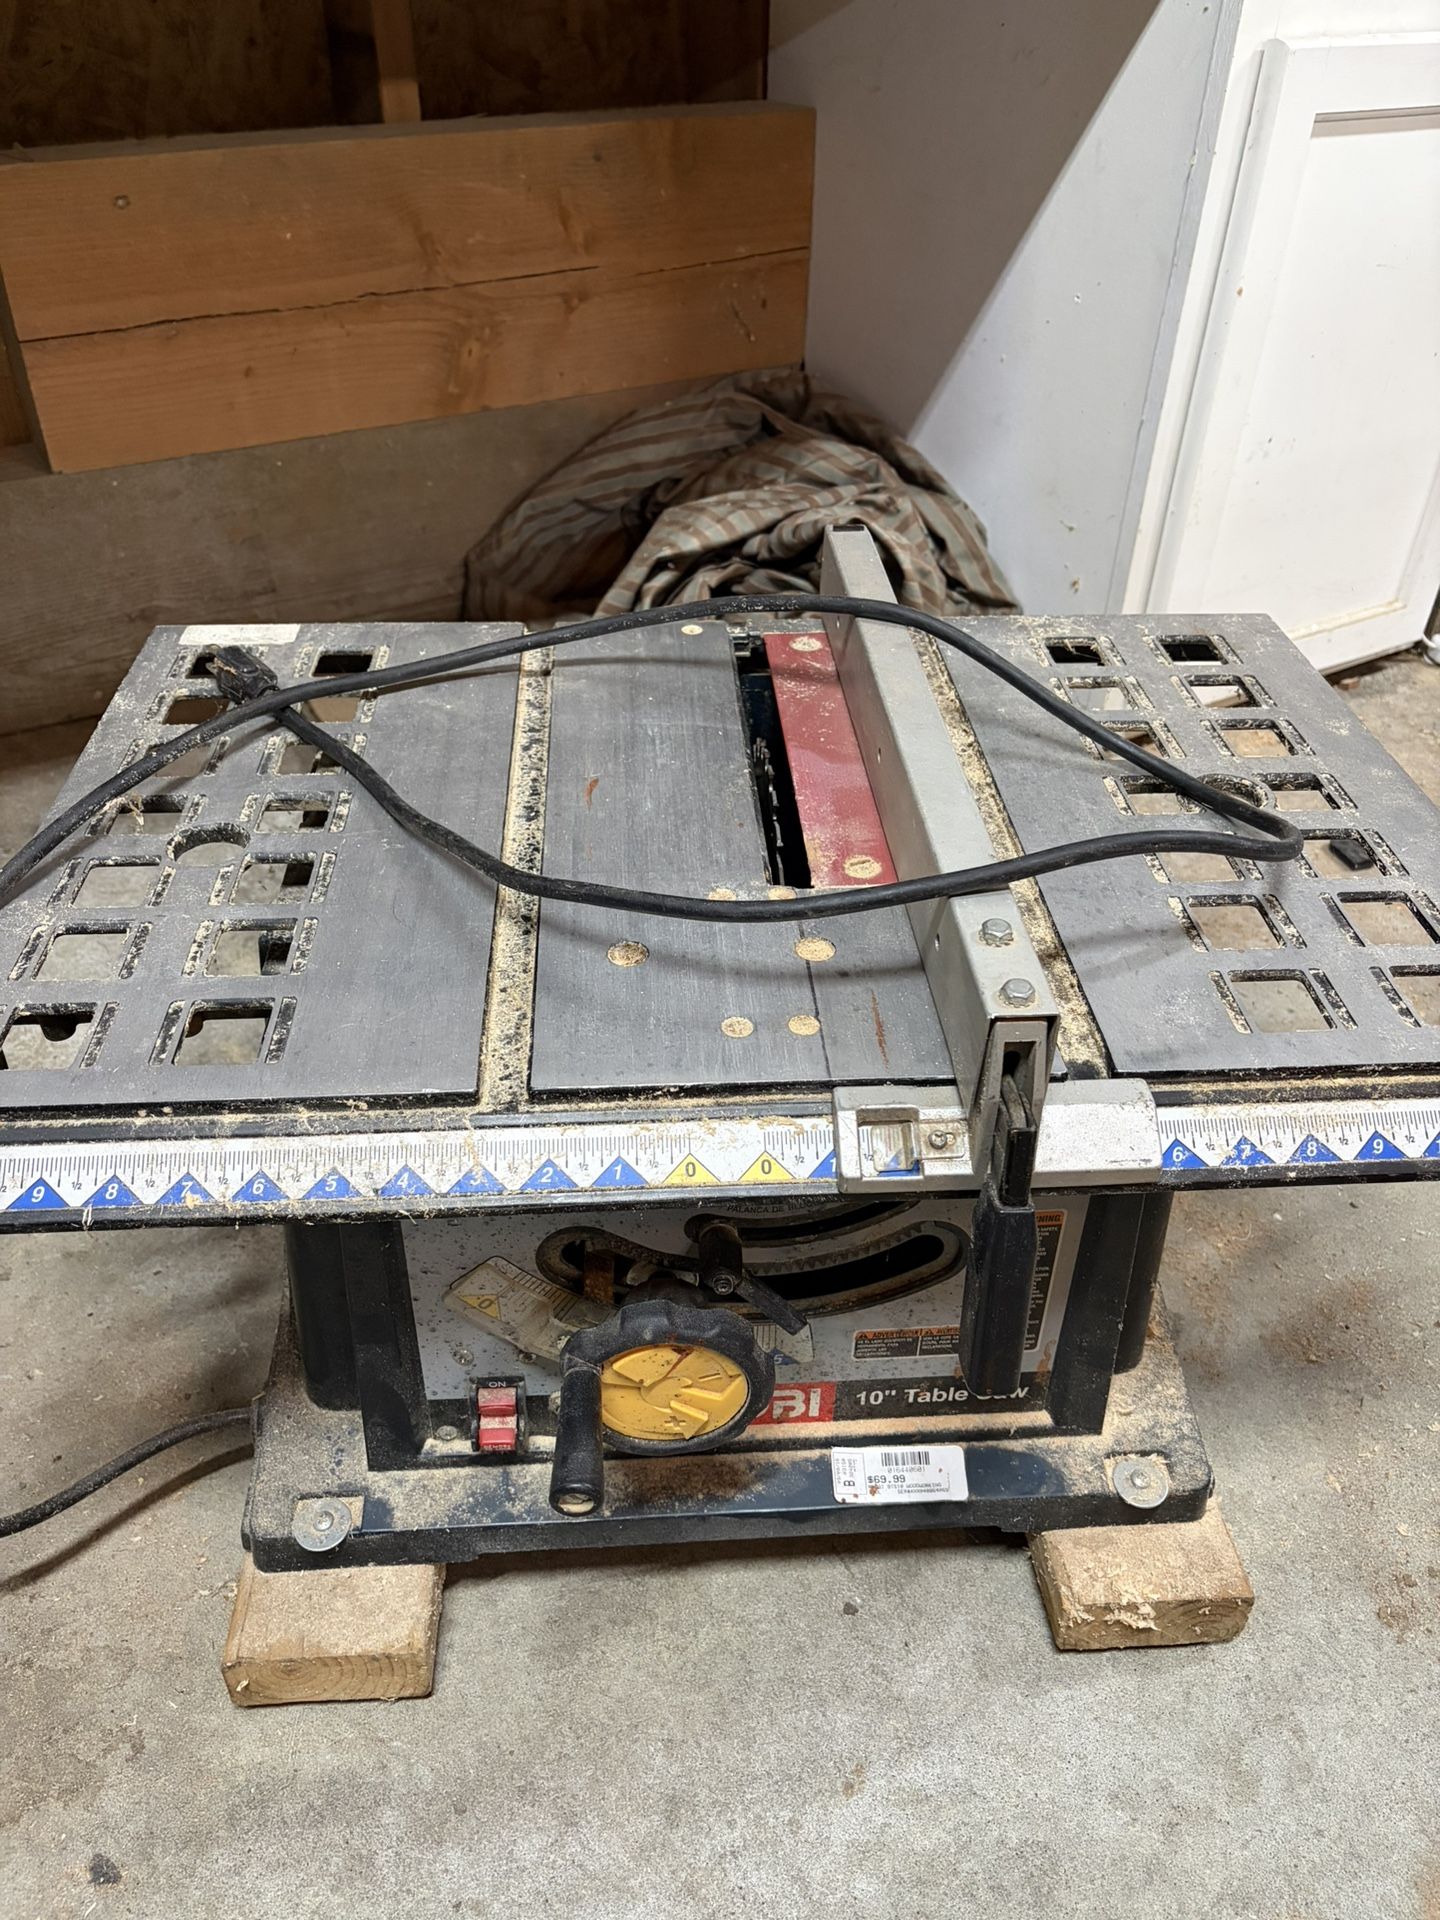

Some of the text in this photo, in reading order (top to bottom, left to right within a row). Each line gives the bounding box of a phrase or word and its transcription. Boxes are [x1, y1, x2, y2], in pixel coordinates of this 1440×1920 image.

[1172, 1146, 1183, 1162] 6
[1240, 1144, 1252, 1160] 7
[1306, 1141, 1318, 1157] 8
[1372, 1139, 1384, 1154] 9
[761, 1159, 772, 1175] 0
[31, 1186, 46, 1203] 9
[105, 1183, 119, 1200] 8
[180, 1181, 194, 1198] 7
[252, 1178, 266, 1195] 6
[325, 1175, 338, 1192] 5
[397, 1173, 409, 1189] 4
[540, 1167, 553, 1183] 2
[614, 1163, 622, 1180] 1
[685, 1161, 696, 1178] 0
[856, 1389, 897, 1406] 10"
[904, 1386, 969, 1404] Table
[843, 1479, 856, 1487] B
[867, 1474, 906, 1484] $69.99
